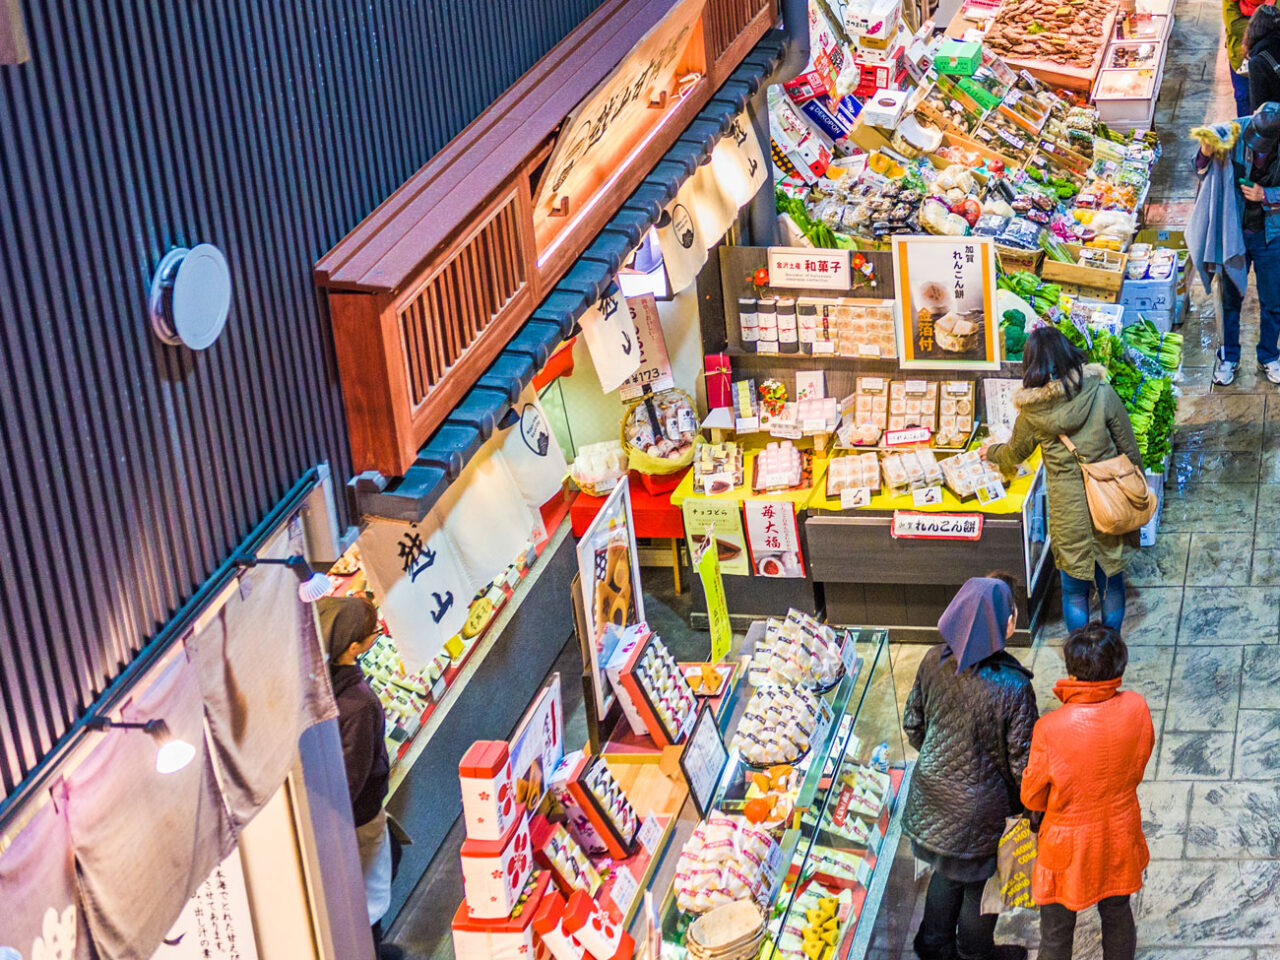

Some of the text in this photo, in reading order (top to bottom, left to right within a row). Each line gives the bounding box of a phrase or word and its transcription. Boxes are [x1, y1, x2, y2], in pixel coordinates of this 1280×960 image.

[813, 103, 841, 134] DEKOPON
[804, 259, 842, 273] 和菓子
[965, 245, 974, 263] 加賀
[953, 250, 964, 299] れんこん餅
[917, 307, 933, 352] 金箔付
[761, 504, 781, 549] 苺大福
[916, 520, 976, 533] れんこん餅
